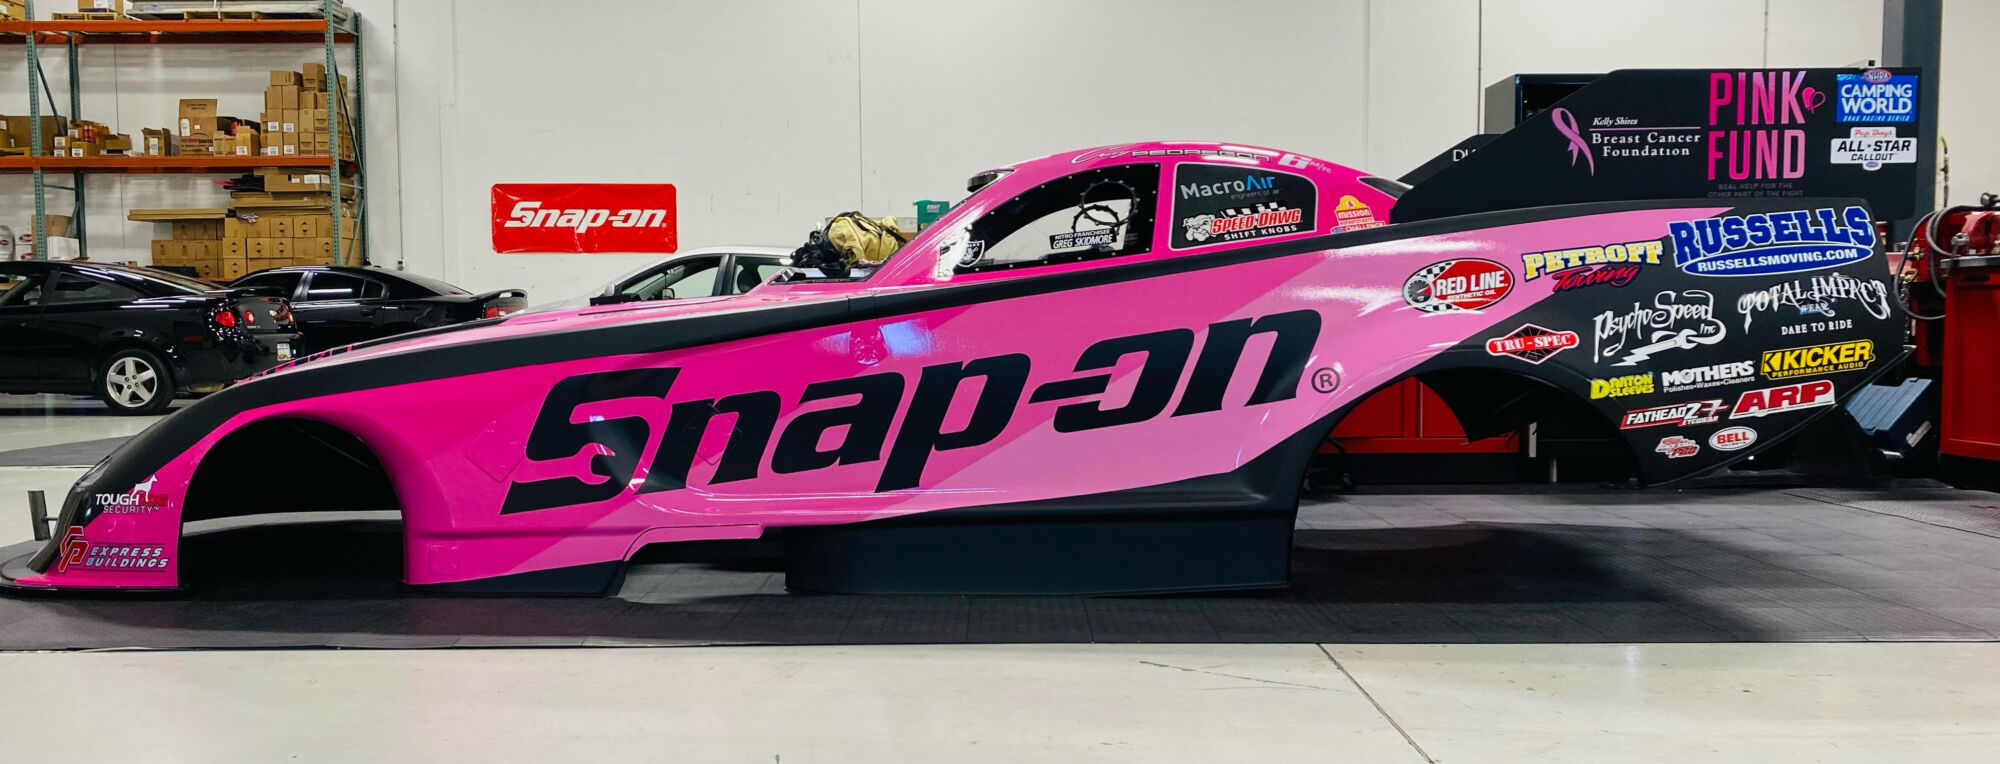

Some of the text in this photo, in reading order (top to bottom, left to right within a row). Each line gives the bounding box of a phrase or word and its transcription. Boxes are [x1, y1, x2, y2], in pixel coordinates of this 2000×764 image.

[1709, 71, 1807, 125] PINK
[1841, 84, 1912, 98] CAMPING
[1841, 98, 1912, 114] WORLD
[1593, 117, 1613, 126] Kelly
[1592, 132, 1701, 144] Breast Cancer
[1603, 145, 1690, 156] Foundation
[1708, 129, 1805, 180] FUND
[1851, 153, 1893, 161] CALLOUT
[1180, 175, 1275, 199] MacroAir
[504, 201, 667, 234] Snap-on
[1212, 208, 1302, 234] SPEED DAWG
[1053, 239, 1073, 249] GREG
[1074, 234, 1113, 247] SKIDMORE
[1055, 228, 1110, 241] NITRO FRANCHISEE
[1224, 225, 1297, 241] SHIFT KNOBS
[1668, 206, 1876, 267] RUSSELLS
[1522, 240, 1663, 281] PETROFF
[1697, 249, 1858, 272] RUSSELLSMOVING.COM
[1436, 270, 1505, 296] RED LINE
[1551, 264, 1640, 292] Towing
[1700, 323, 1716, 334] Inc
[1781, 319, 1852, 336] DARE TO RIDE
[1783, 341, 1871, 371] KICKER
[1662, 361, 1754, 386] MOTHERS
[1772, 362, 1863, 378] PERFORMANCE AUDIO
[1591, 372, 1654, 399] DARTON
[1609, 385, 1654, 397] SLEEVES
[1734, 381, 1832, 414] ARP
[501, 309, 1321, 514] Snap-on
[1717, 432, 1749, 444] BELL
[91, 547, 163, 557] EXPRESS
[85, 558, 168, 568] BUILDINGS
